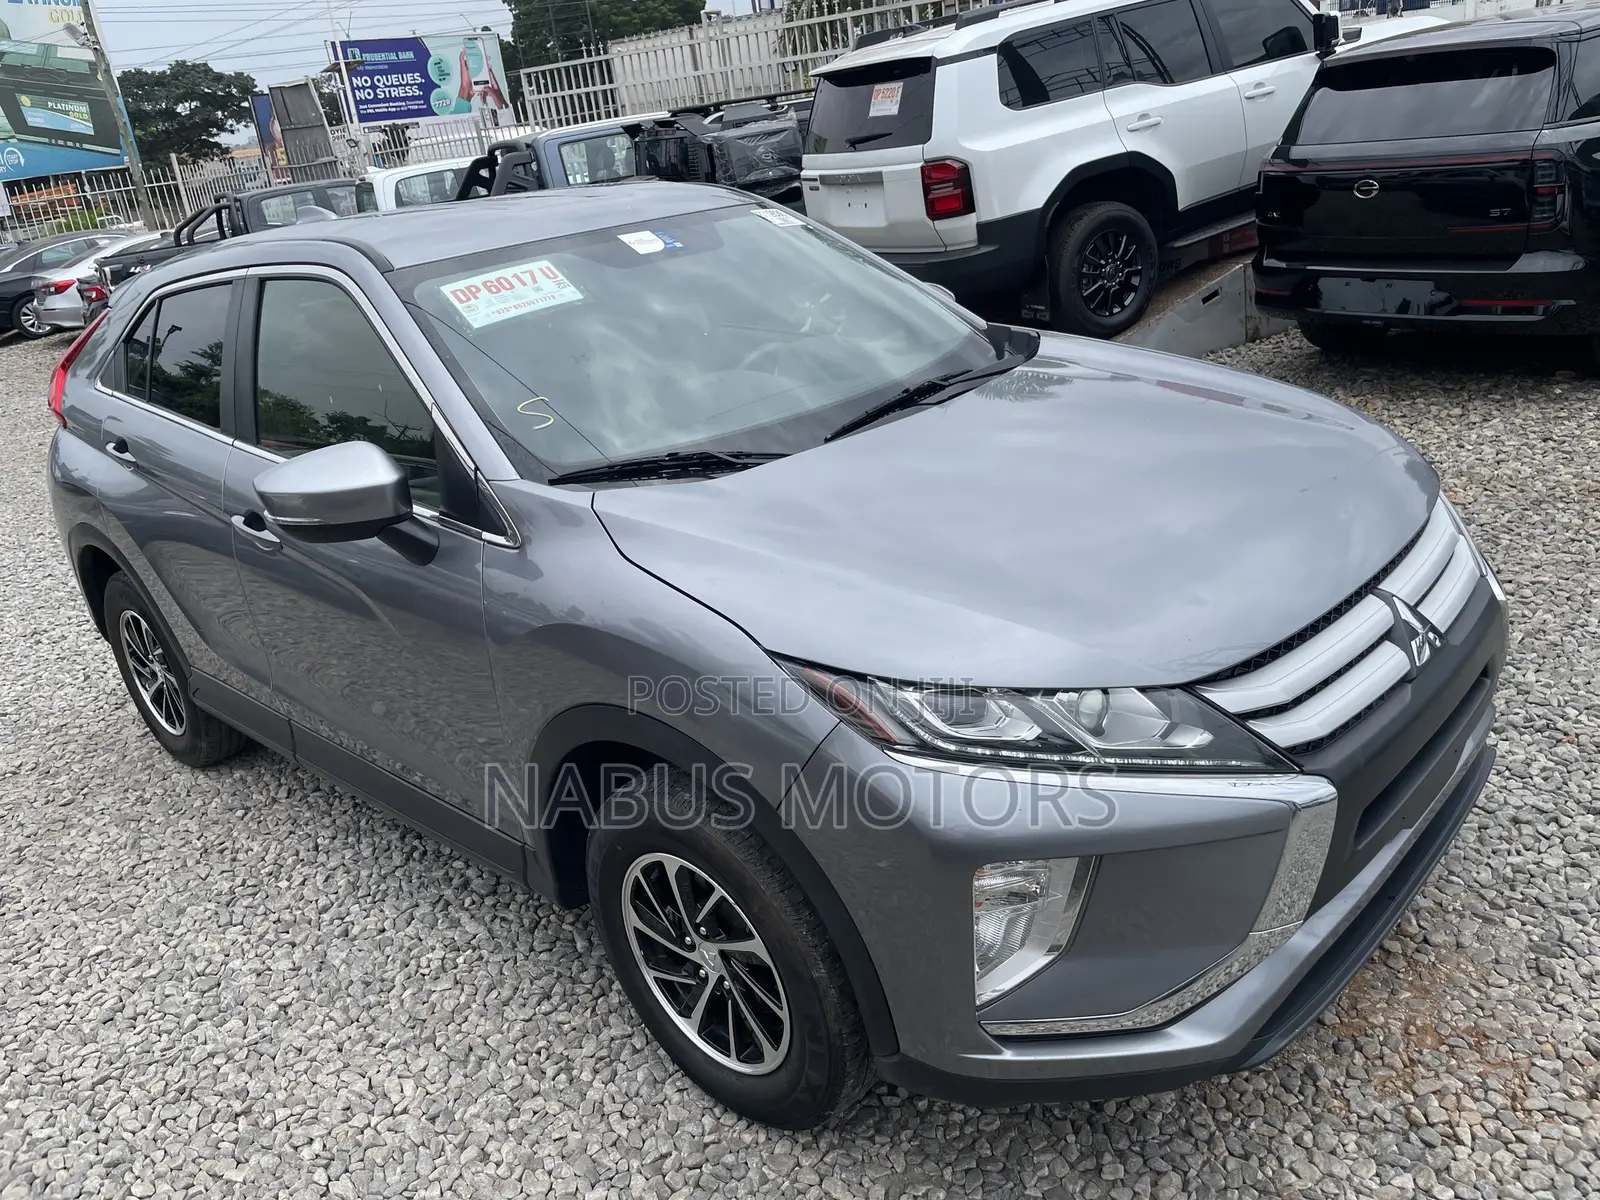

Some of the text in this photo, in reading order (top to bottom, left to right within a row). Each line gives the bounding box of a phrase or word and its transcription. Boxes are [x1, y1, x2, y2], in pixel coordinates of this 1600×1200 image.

[362, 52, 398, 61] PRUDENTIAL
[398, 51, 414, 59] BANK
[352, 73, 425, 87] NO QUEUES.
[355, 85, 423, 100] NO STRESS.
[47, 101, 87, 113] PLATINUM
[69, 111, 88, 119] GOLD
[1490, 208, 1511, 217] S7
[450, 284, 482, 304] DP
[482, 269, 538, 295] 6017
[538, 265, 560, 280] U
